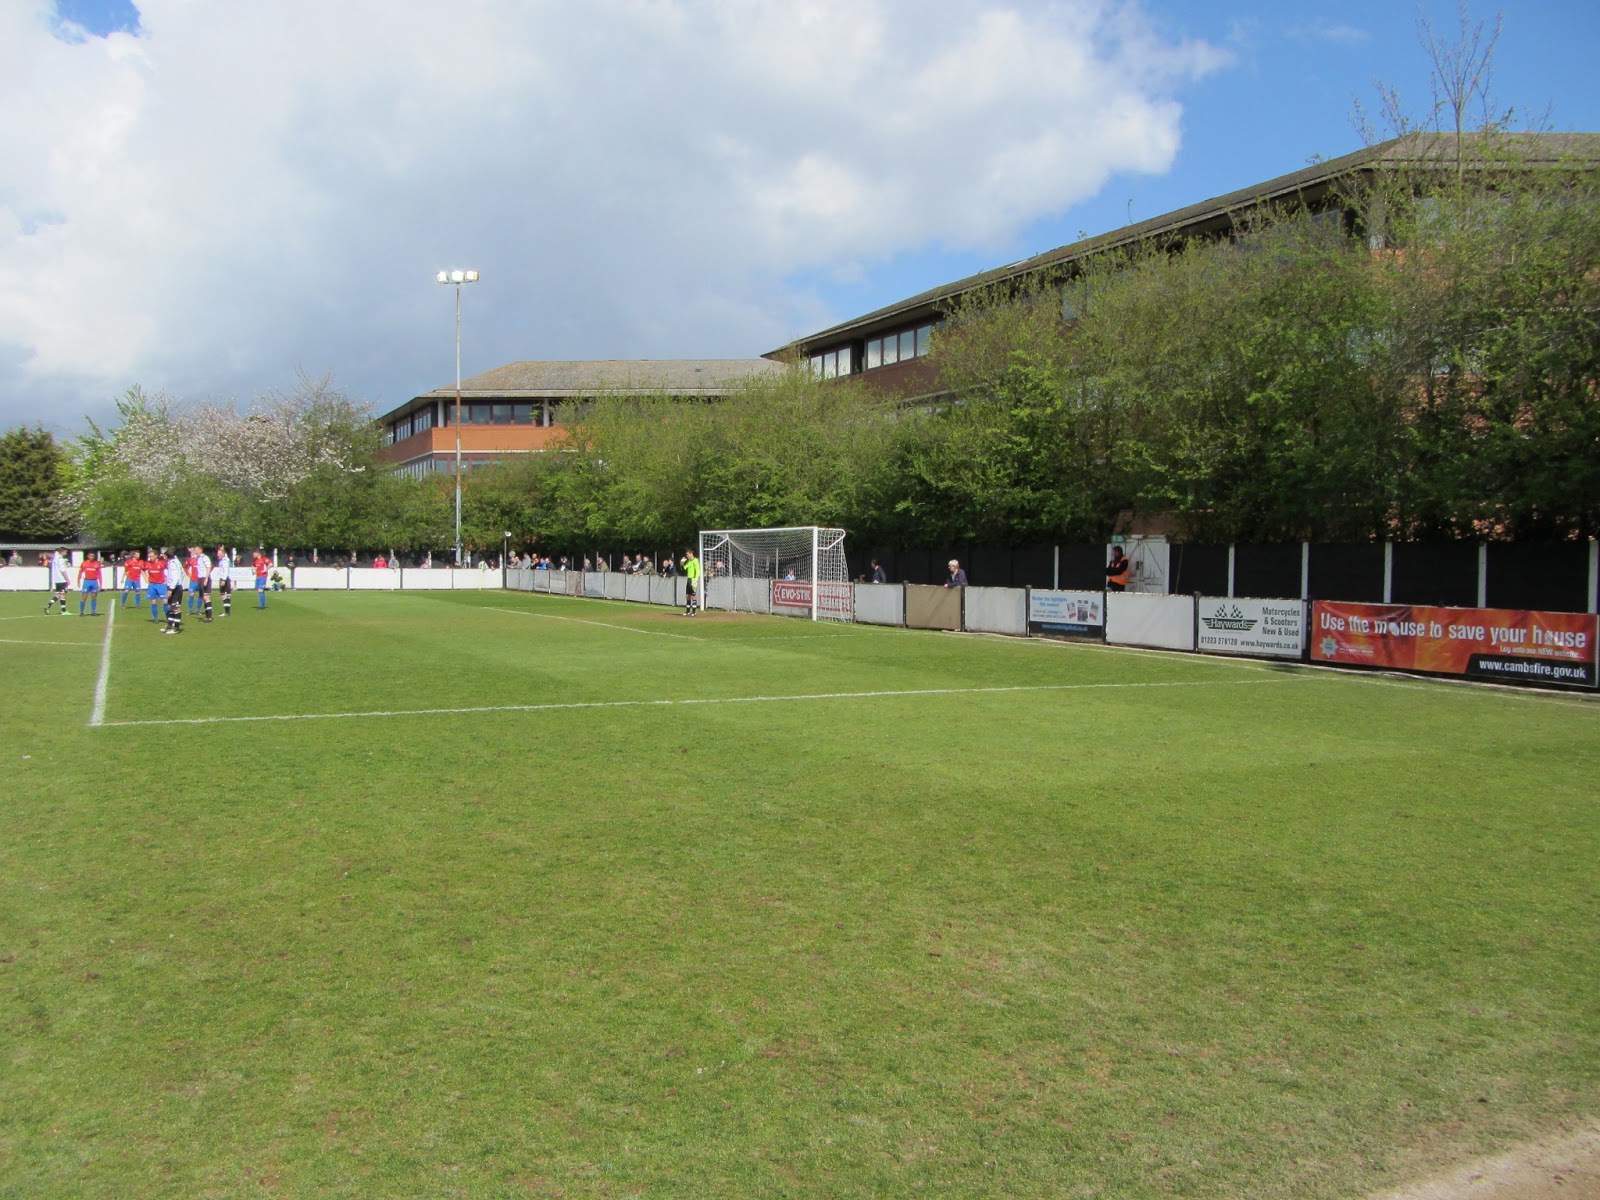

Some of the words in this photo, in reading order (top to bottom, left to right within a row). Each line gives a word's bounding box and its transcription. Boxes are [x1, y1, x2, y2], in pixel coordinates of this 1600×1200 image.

[1262, 607, 1300, 617] Motorcycles
[1210, 619, 1249, 630] Haywards
[1270, 617, 1298, 627] Scooters
[1262, 627, 1276, 635] New
[1278, 628, 1282, 636] &
[1284, 628, 1300, 636] Used
[1321, 612, 1345, 631] Use
[1348, 615, 1370, 633] the
[1430, 620, 1443, 639] to
[1448, 624, 1485, 641] save
[1490, 627, 1527, 646] your
[1201, 636, 1217, 644] 01223
[1240, 640, 1299, 649] www.haywards.co.uk
[1479, 660, 1586, 679] www.cambsfire.gov.uk
